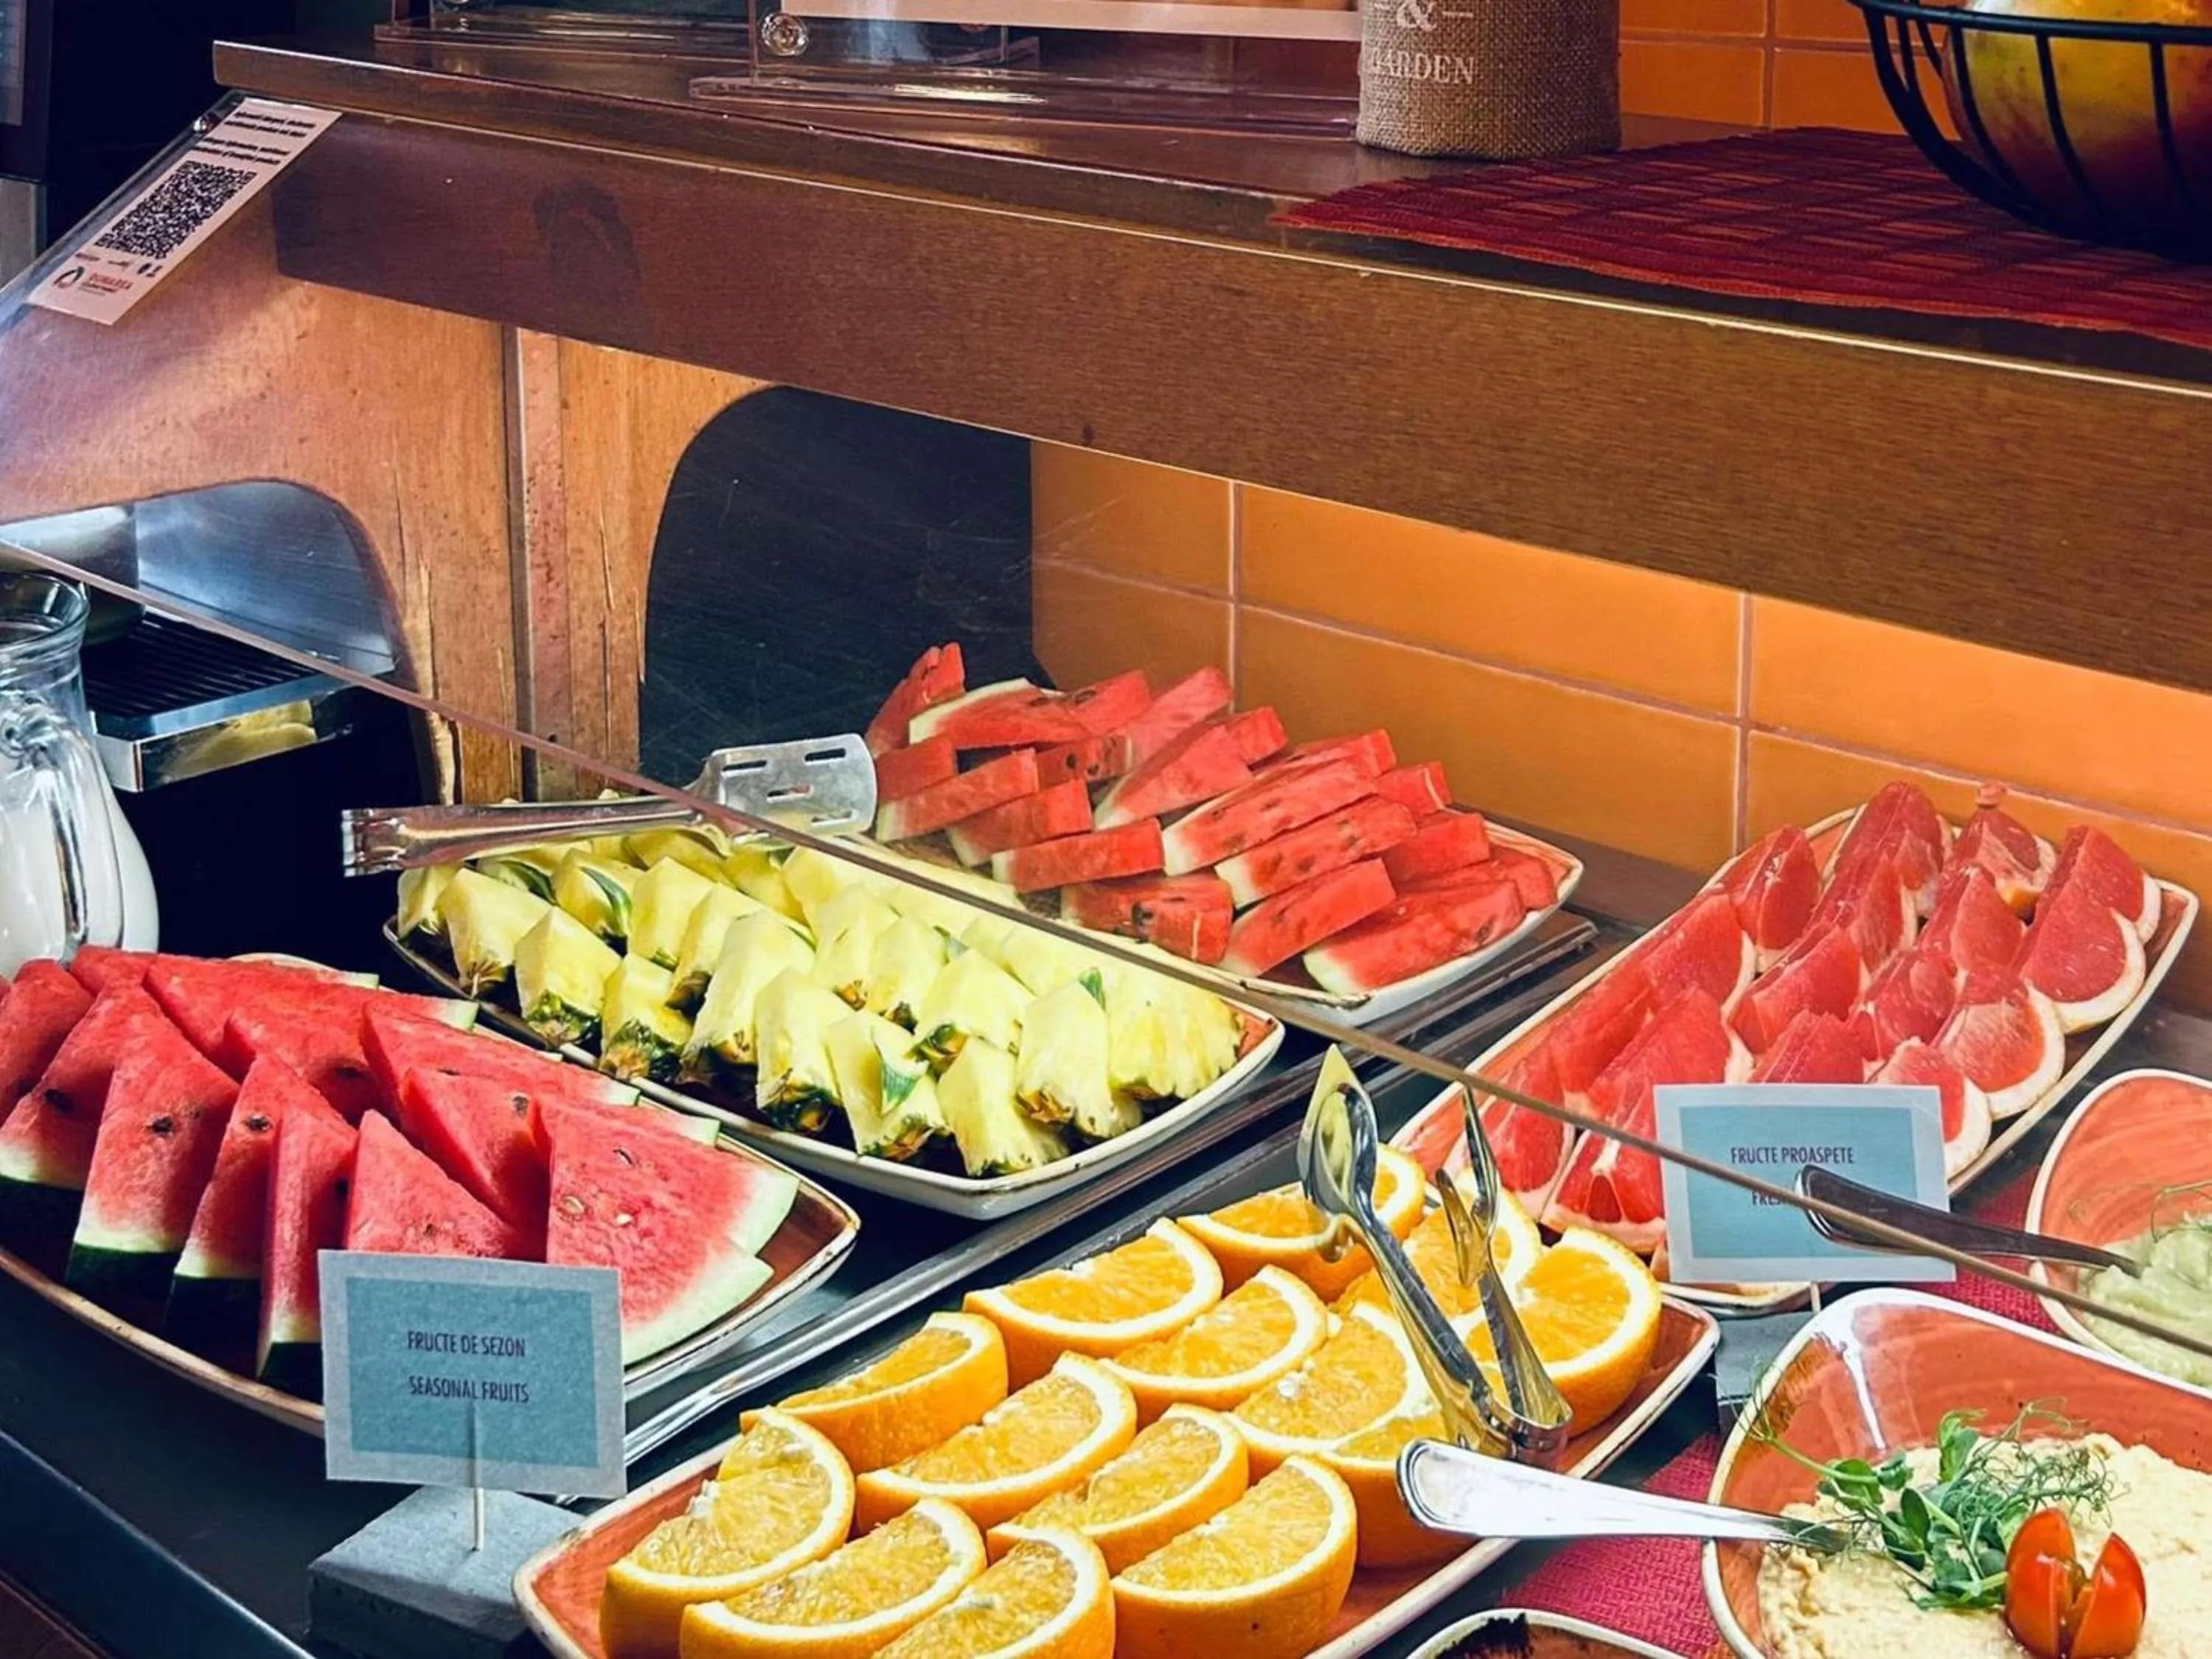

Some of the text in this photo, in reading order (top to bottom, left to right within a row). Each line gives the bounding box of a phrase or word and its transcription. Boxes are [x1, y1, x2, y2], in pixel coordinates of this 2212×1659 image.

[1731, 1147, 1854, 1164] FRUCTE PROASPETE
[408, 1330, 526, 1357] FRUCTE DE SEZON
[408, 1374, 529, 1403] SEASONAL FRUITS
